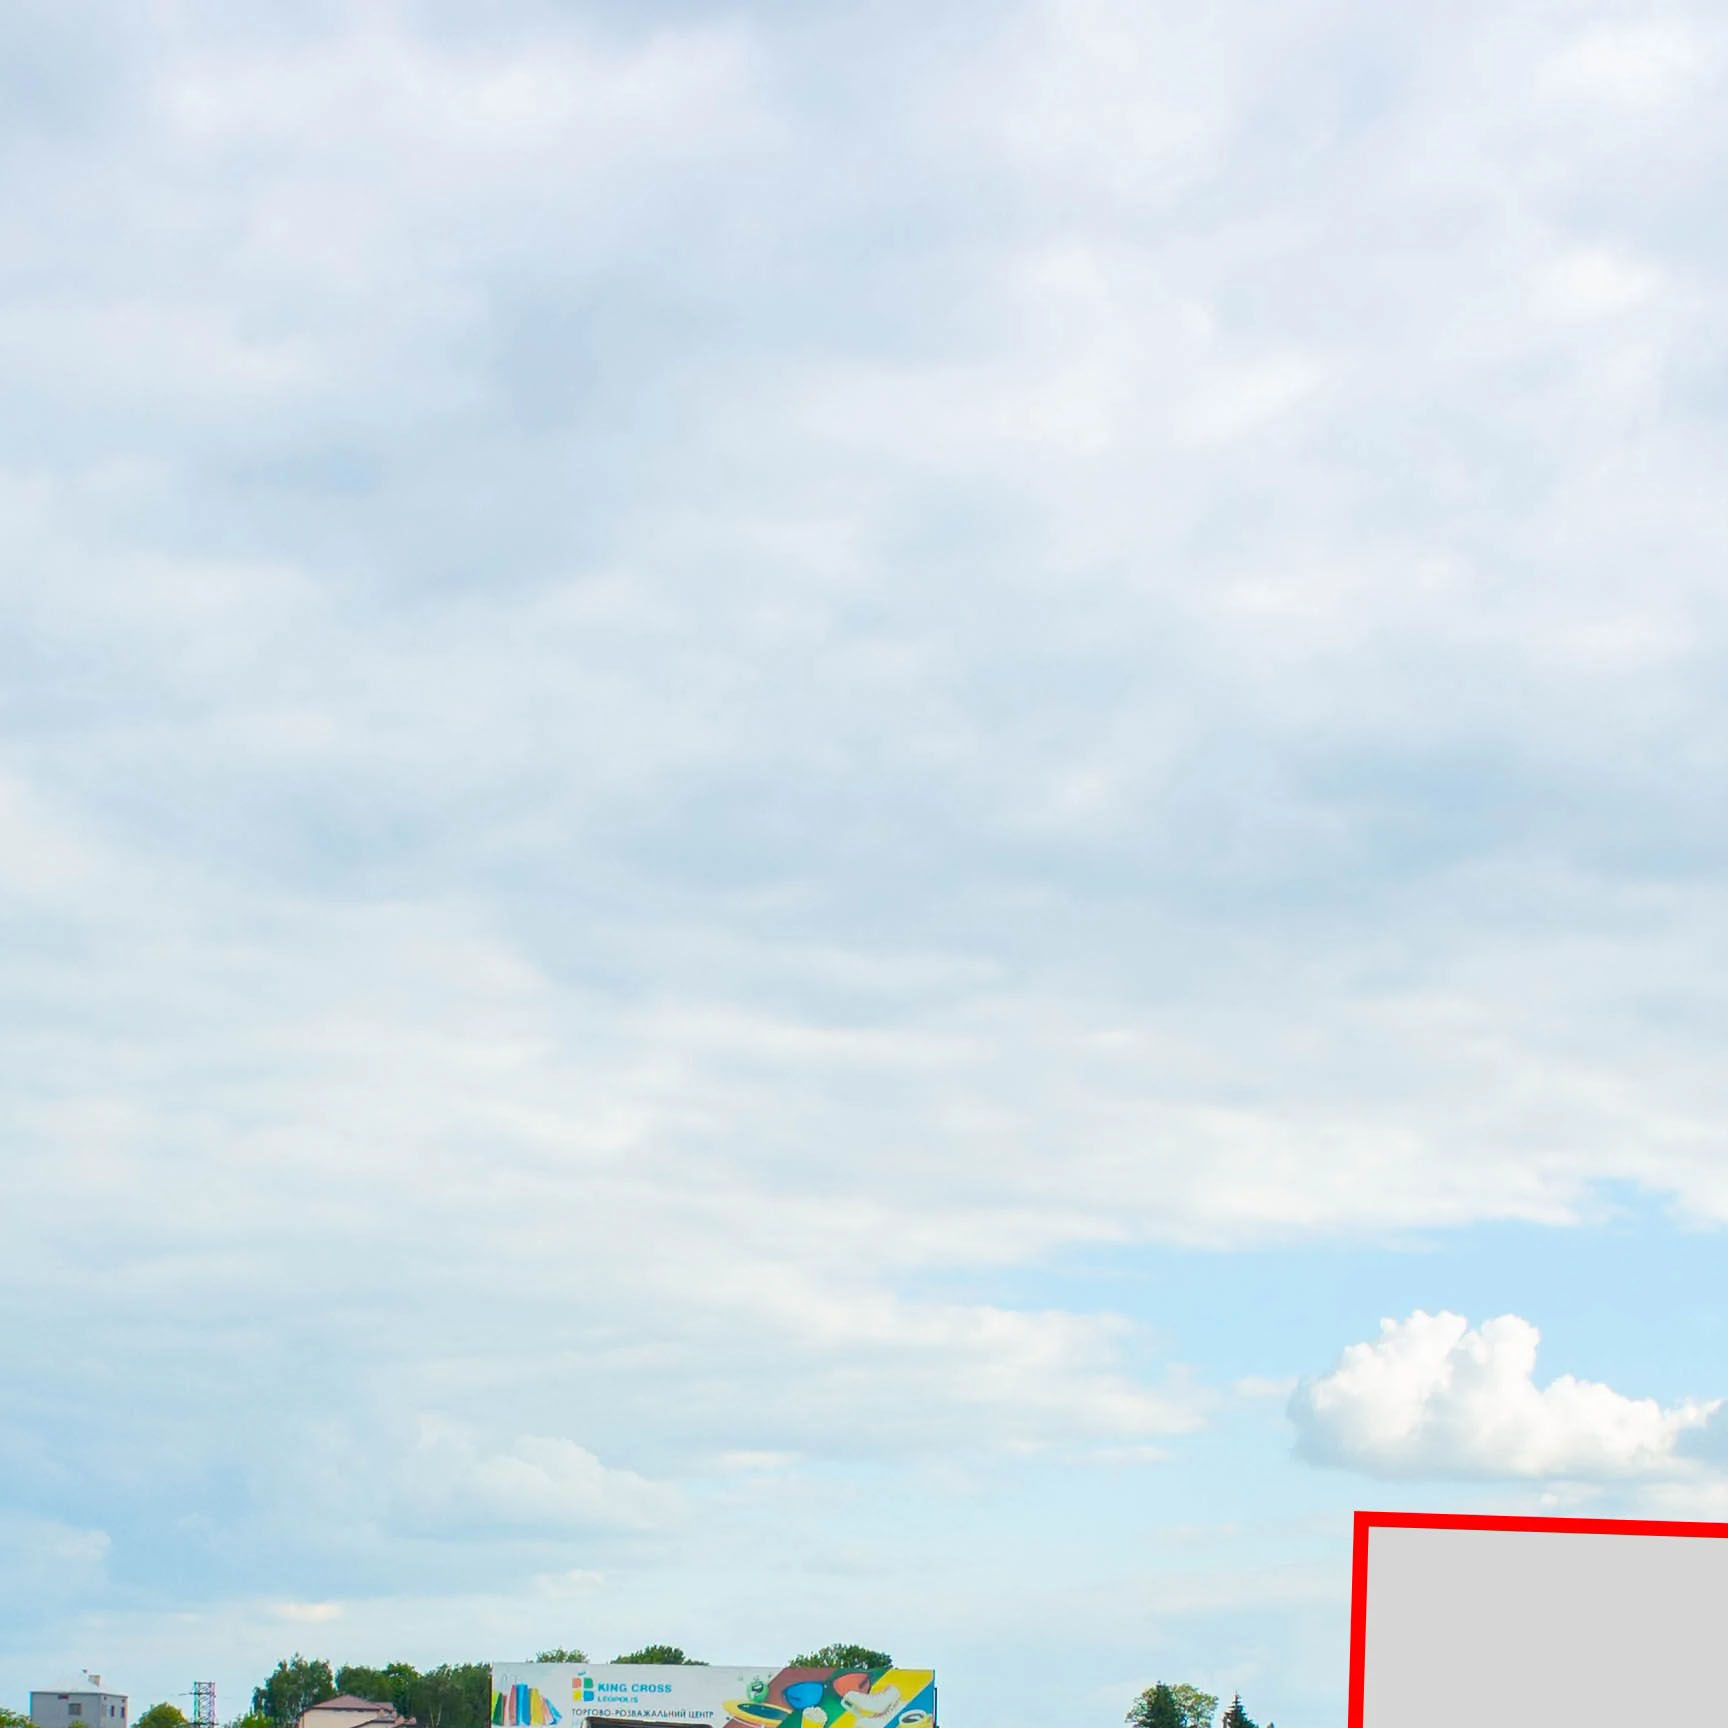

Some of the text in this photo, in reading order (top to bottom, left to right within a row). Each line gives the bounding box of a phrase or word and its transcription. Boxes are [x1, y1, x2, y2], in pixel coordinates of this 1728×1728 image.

[597, 1683, 672, 1693] KING CROSS
[572, 1708, 714, 1719] ТОРГОВО-РОЗВАЖАЛЬНИЙ ЦЕНТР
